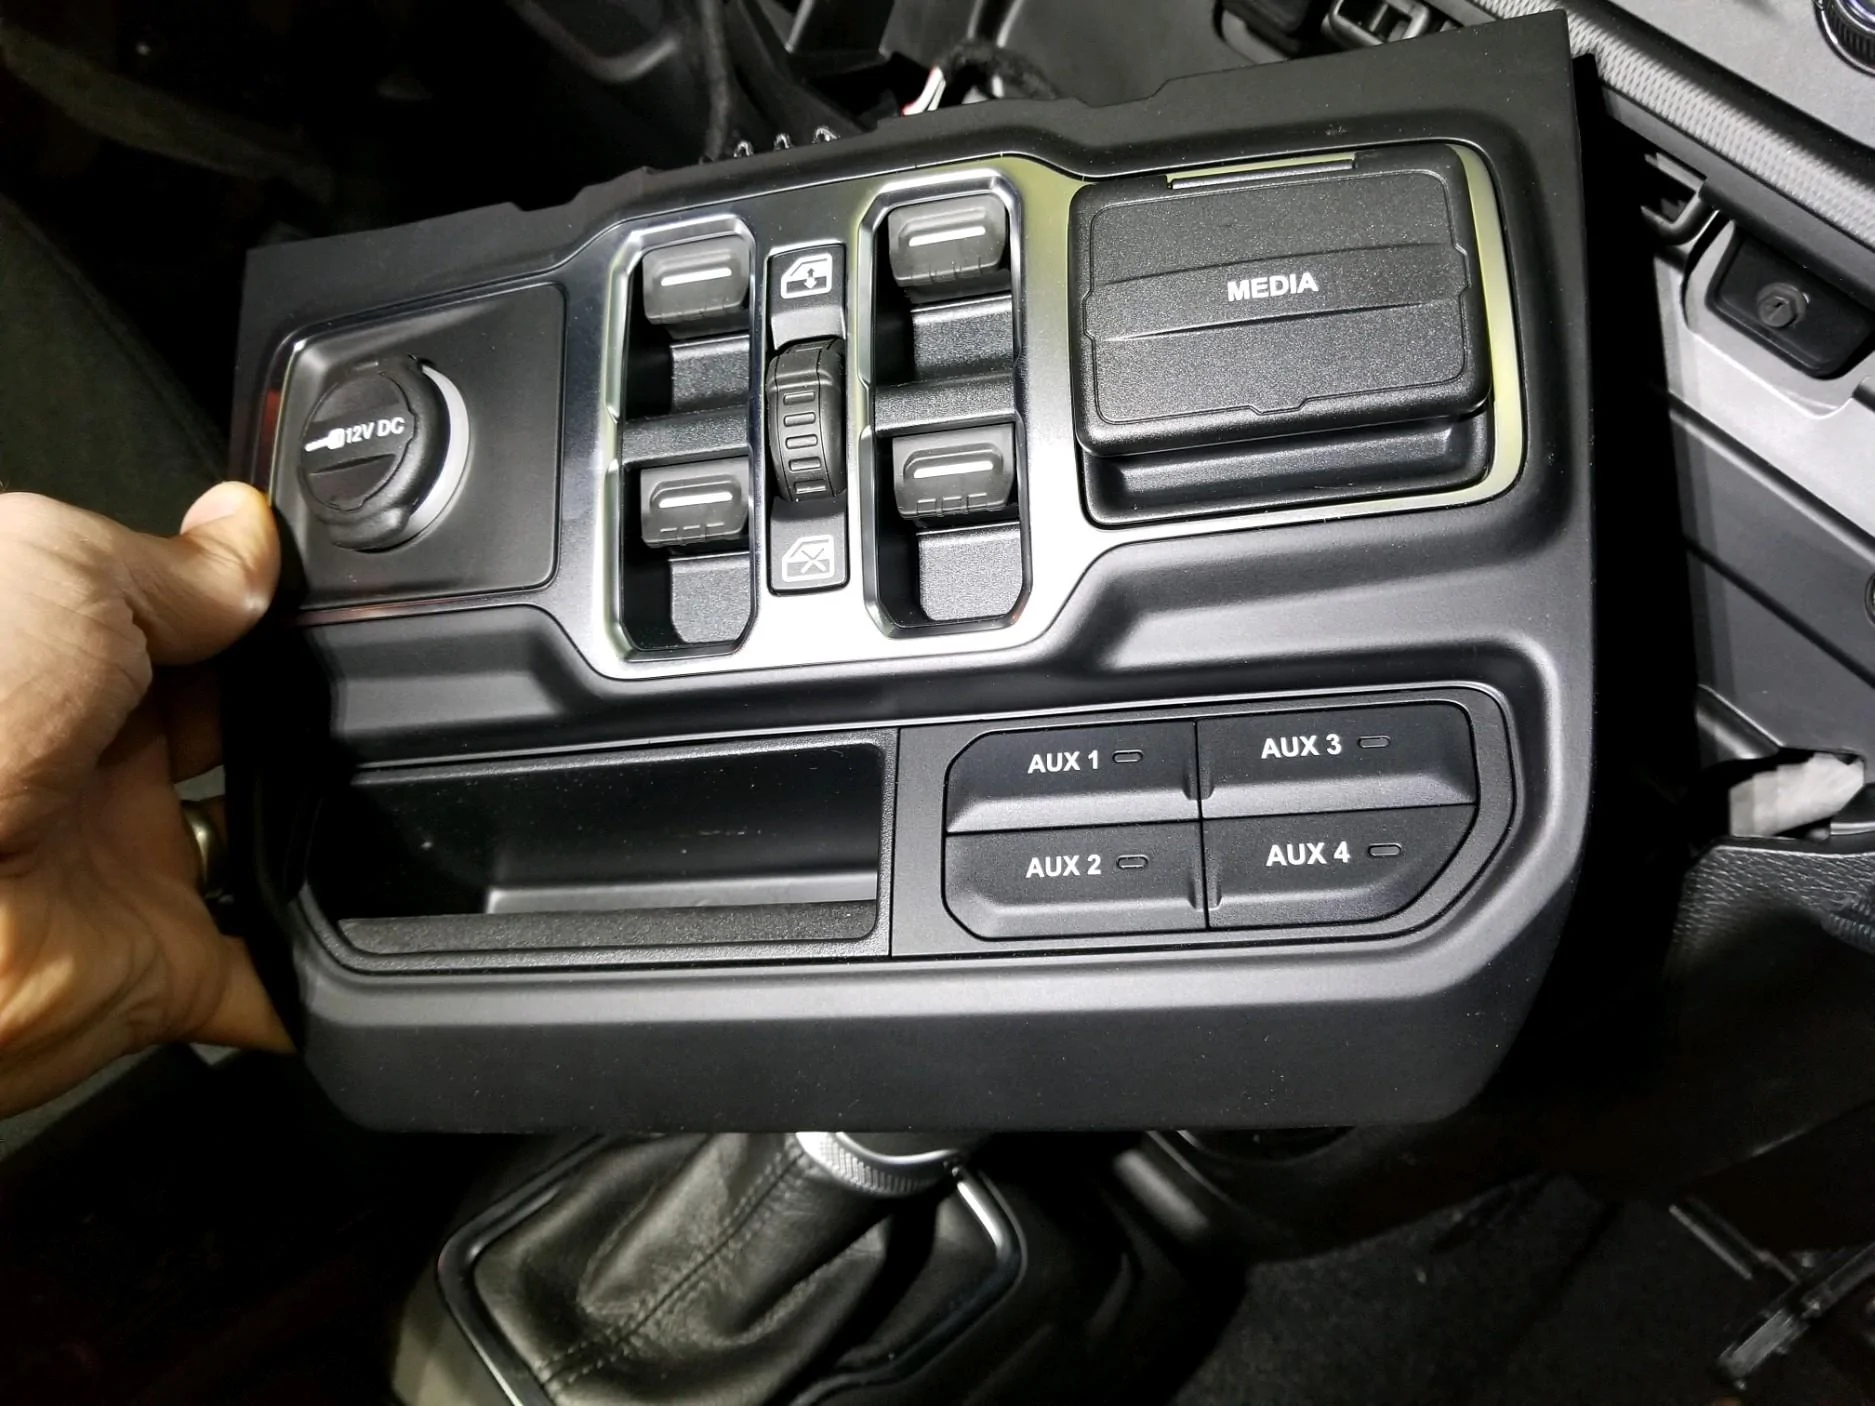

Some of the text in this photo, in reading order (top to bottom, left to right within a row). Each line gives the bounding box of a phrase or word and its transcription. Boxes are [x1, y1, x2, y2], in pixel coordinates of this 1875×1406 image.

[1227, 271, 1319, 302] MEDIA
[345, 416, 405, 444] 12V DC
[1260, 733, 1342, 759] AUX 3
[1027, 749, 1099, 774] AUX 1
[1025, 853, 1102, 879] AUX 2
[1265, 840, 1351, 867] AUX 4
